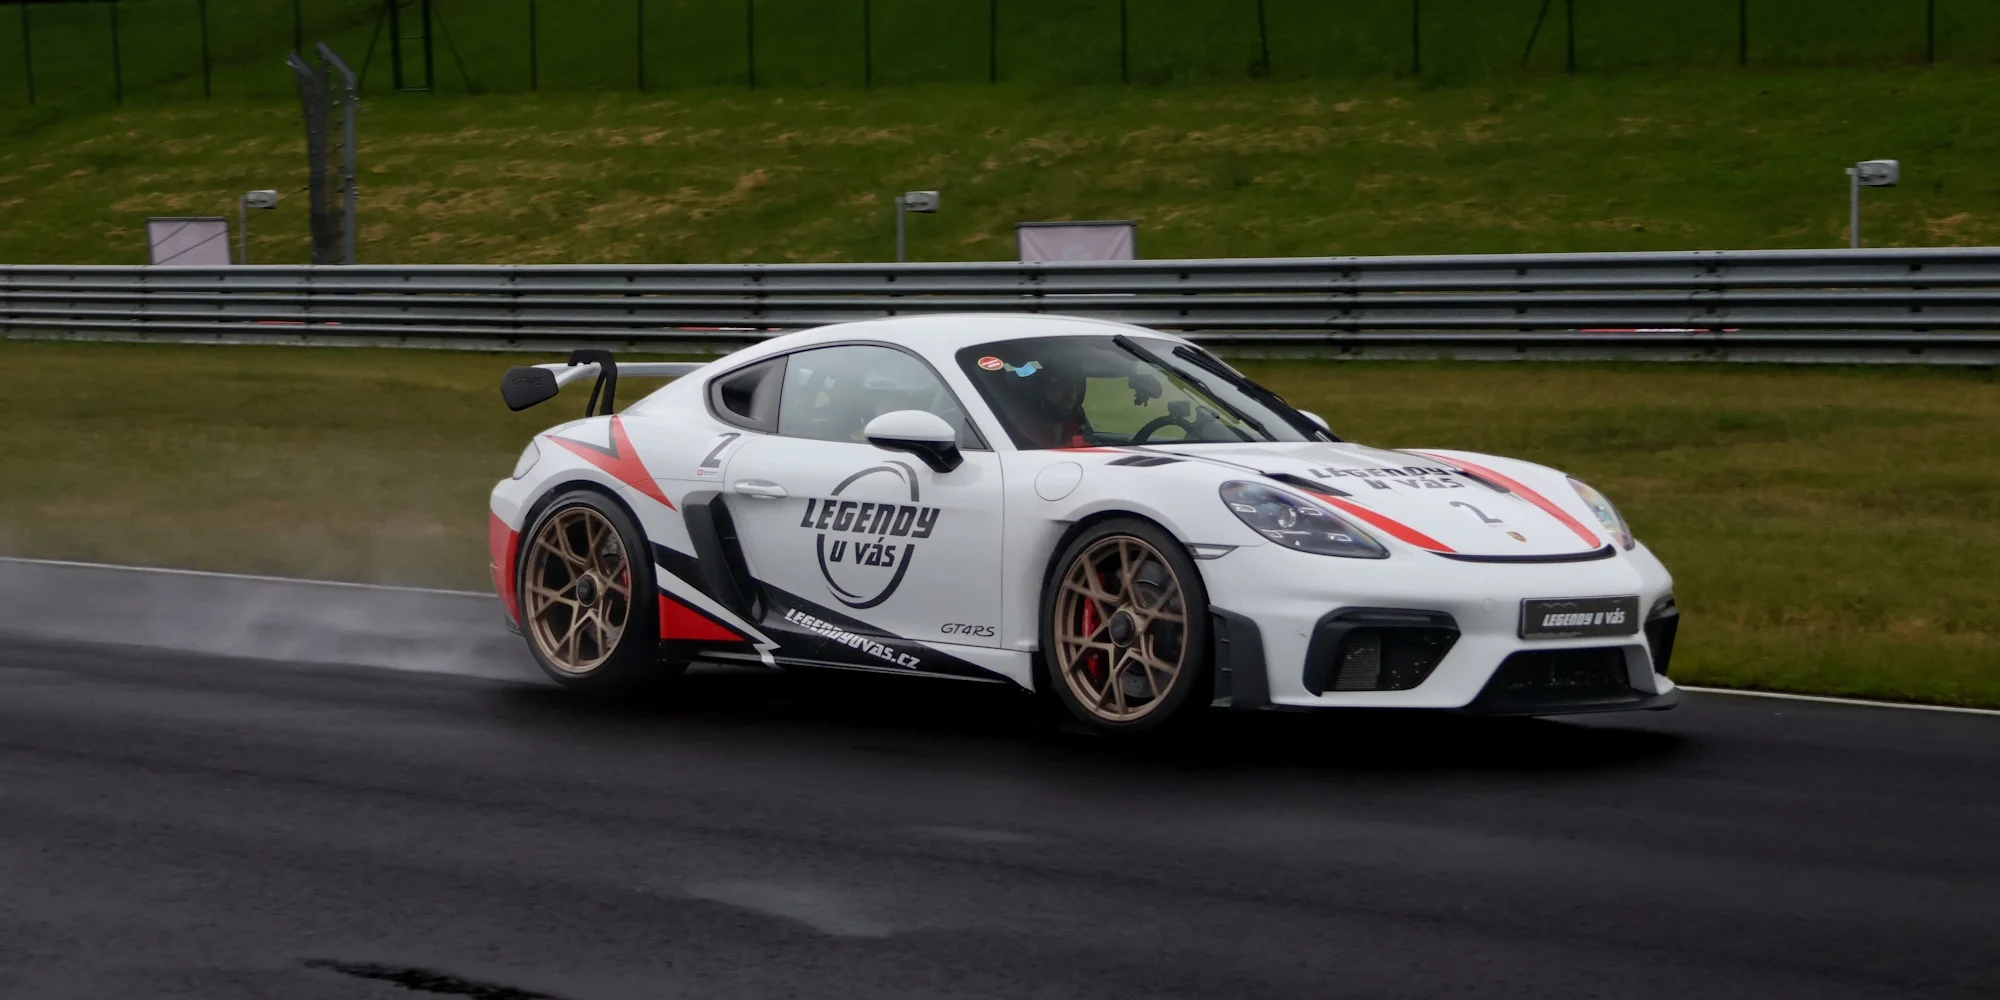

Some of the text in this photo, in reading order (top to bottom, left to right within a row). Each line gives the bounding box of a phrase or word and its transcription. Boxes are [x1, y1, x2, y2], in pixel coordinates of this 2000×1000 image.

[700, 432, 741, 468] 2
[1308, 466, 1451, 479] LEGENDY
[800, 498, 940, 539] LEGENDY
[1450, 501, 1504, 523] 2
[1542, 613, 1594, 627] LEGENDY
[941, 623, 995, 638] GT4RS
